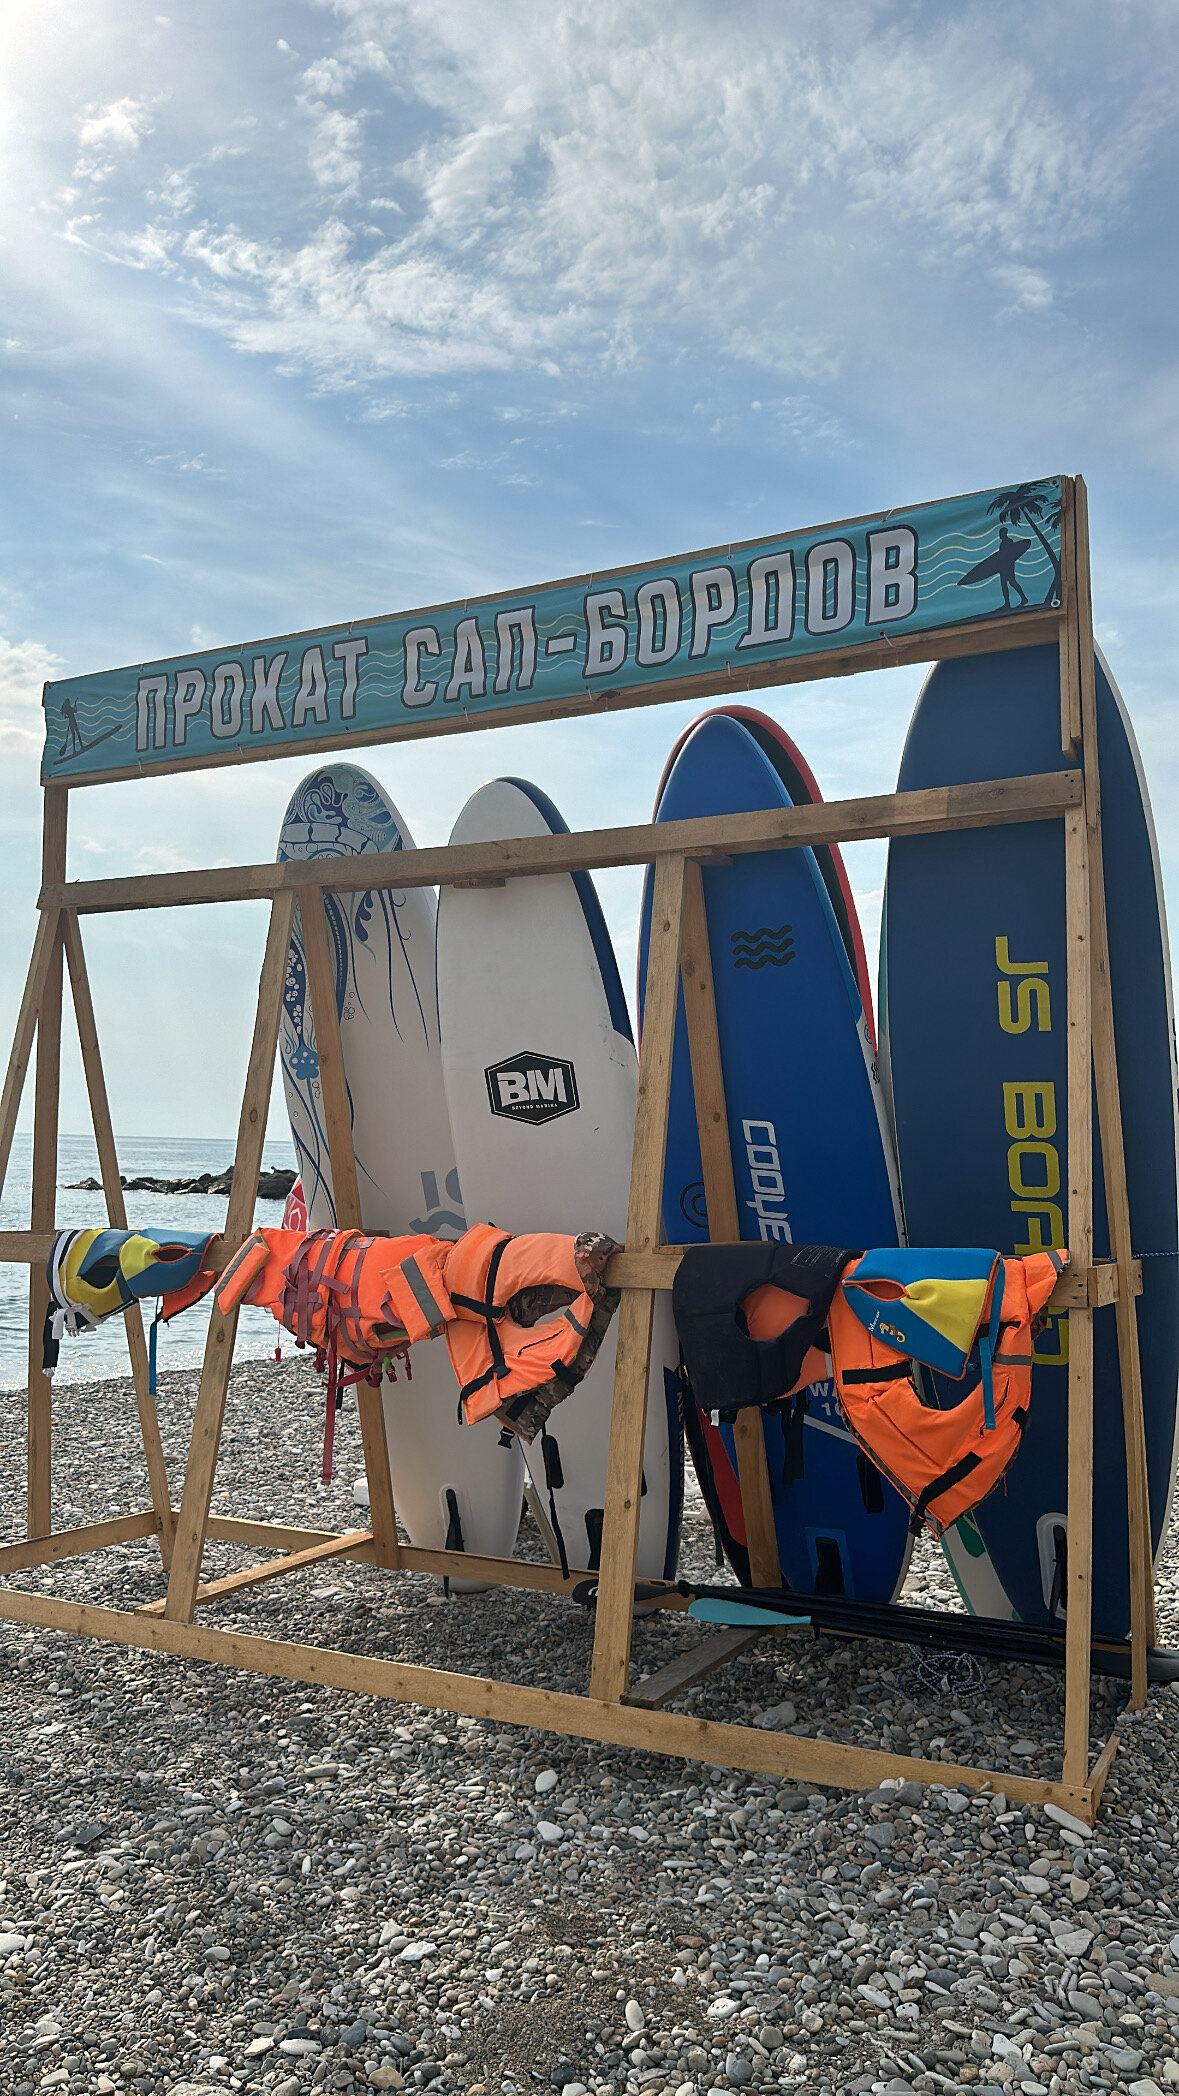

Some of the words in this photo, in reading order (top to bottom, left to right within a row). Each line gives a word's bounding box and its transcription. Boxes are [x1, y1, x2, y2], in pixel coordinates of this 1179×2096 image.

[136, 636, 368, 752] ПРОКАТ
[400, 525, 919, 708] САП-БОРДОВ
[995, 936, 1052, 1034] JS
[496, 1067, 568, 1107] BM
